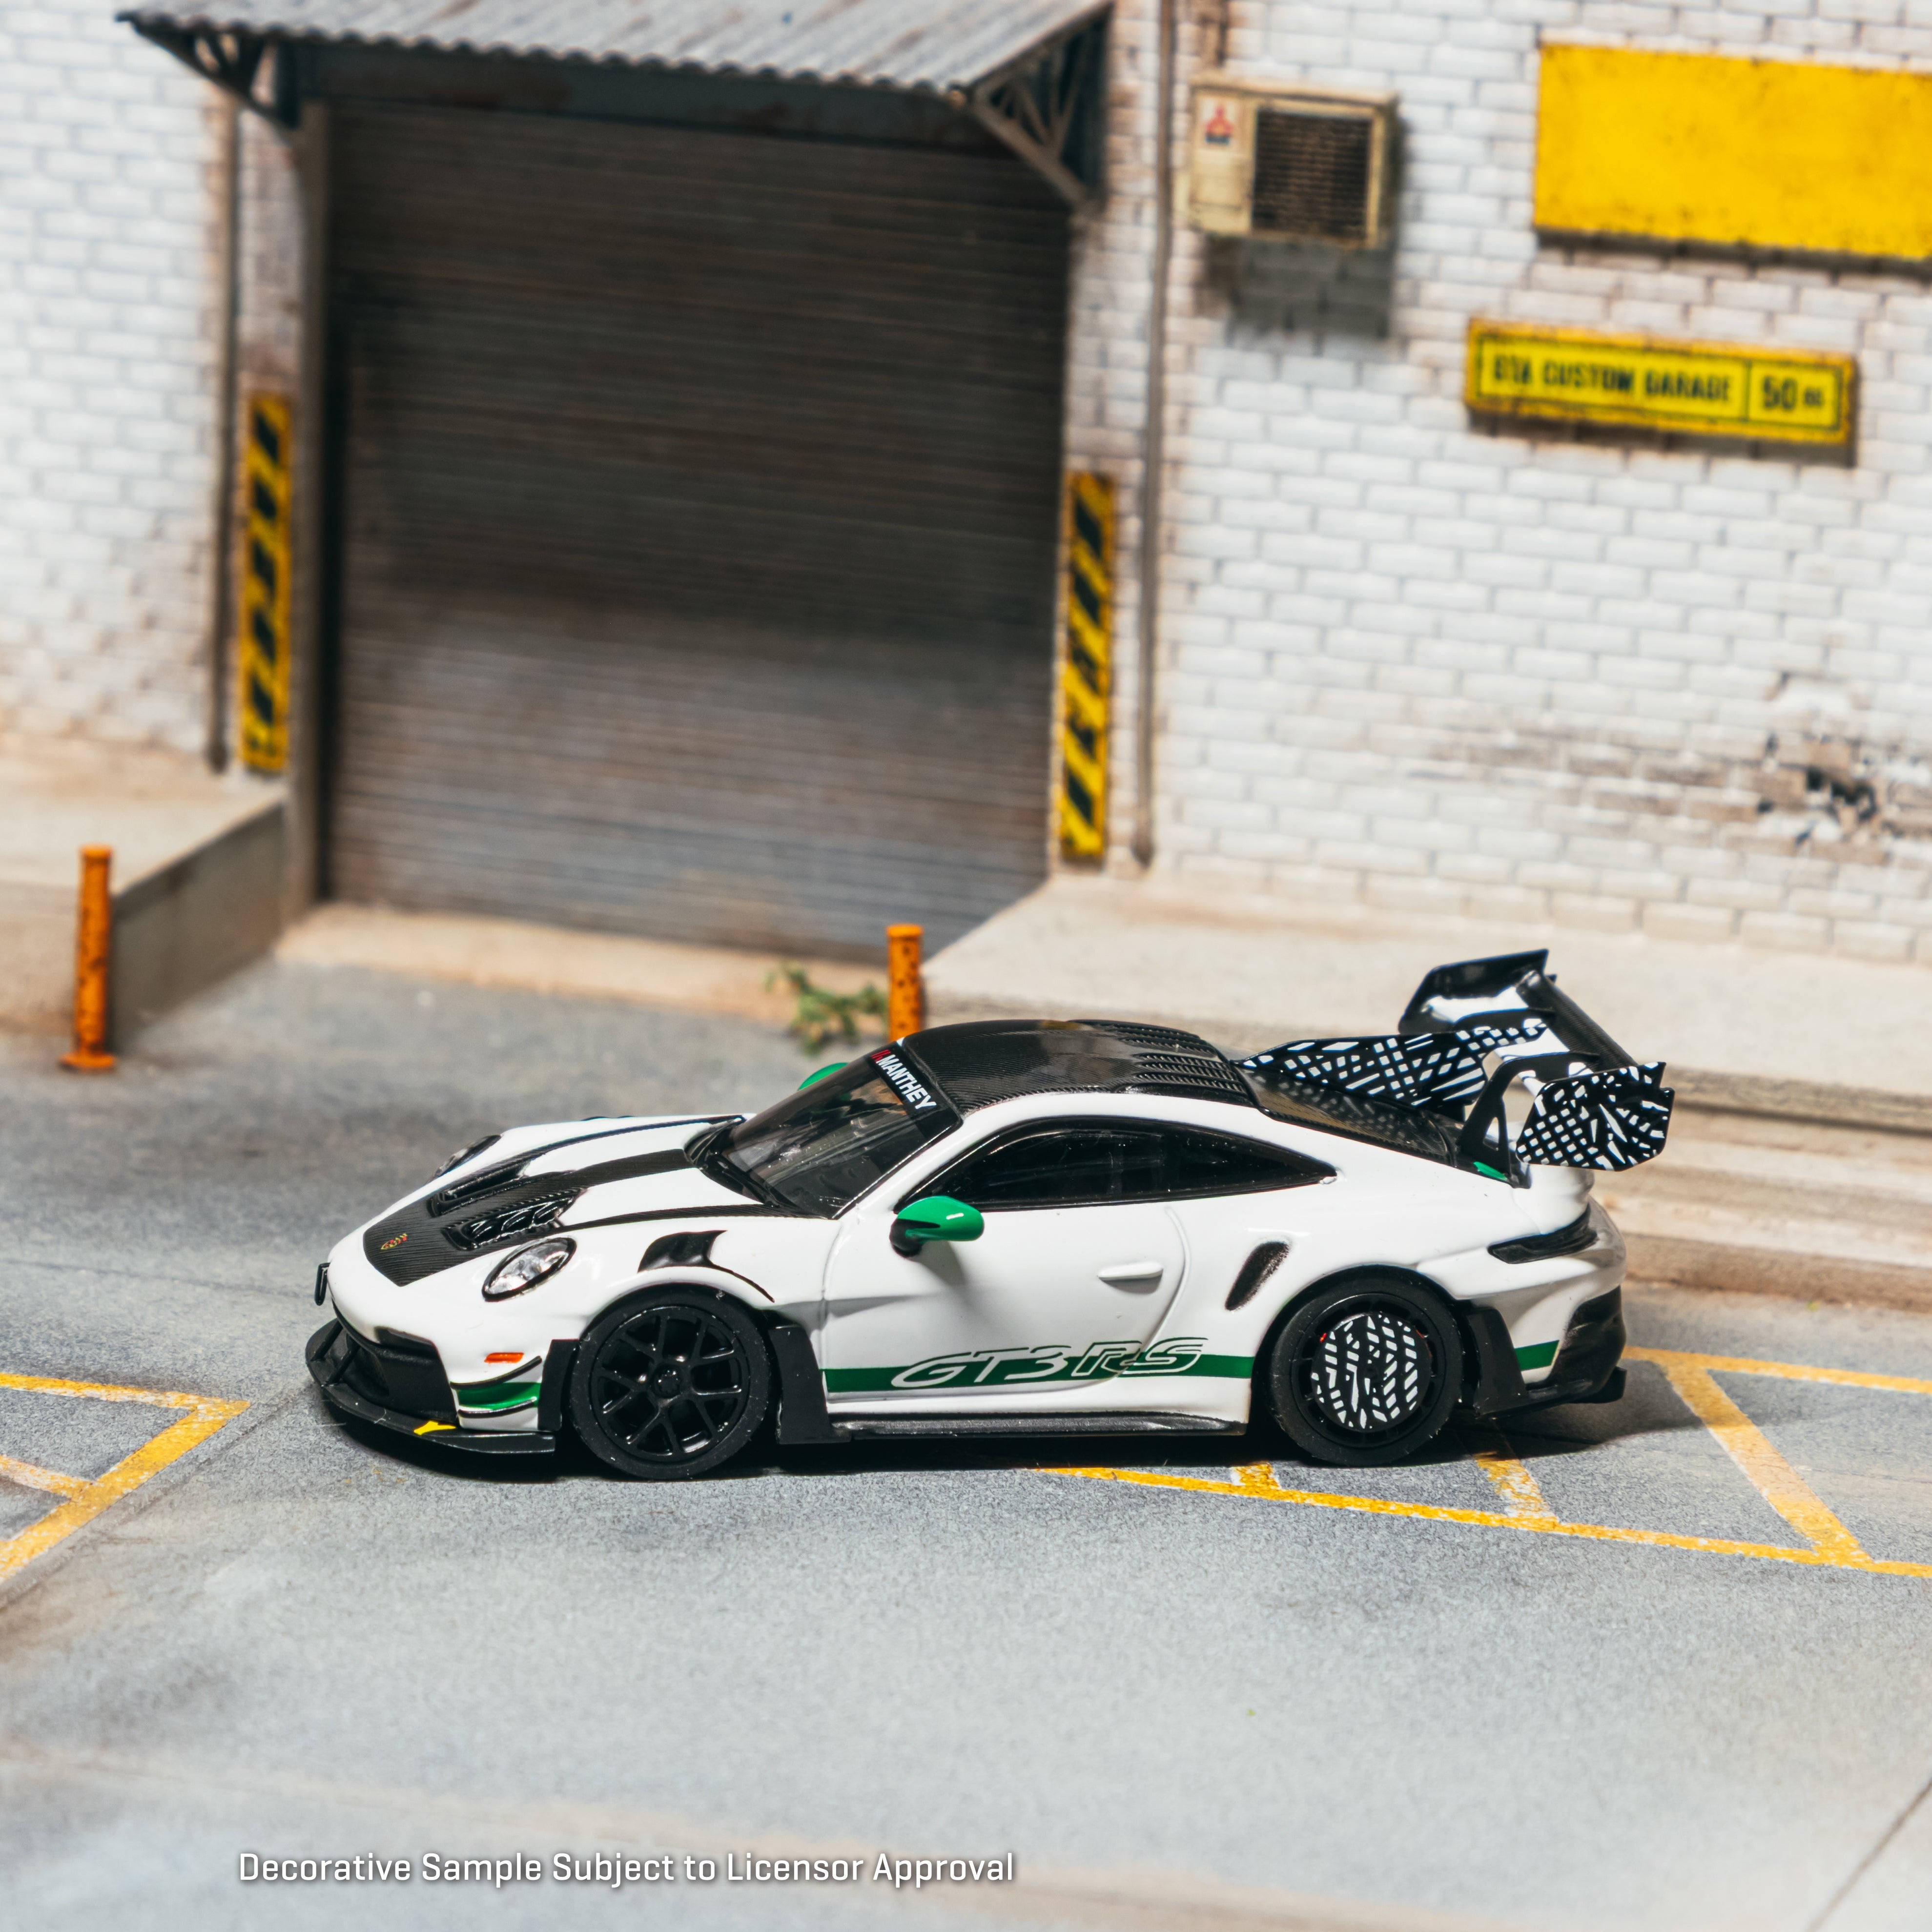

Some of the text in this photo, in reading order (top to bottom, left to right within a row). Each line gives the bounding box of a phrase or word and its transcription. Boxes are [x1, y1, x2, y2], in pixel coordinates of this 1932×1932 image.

[1543, 360, 1634, 392] CUSTOM
[1645, 370, 1730, 402] GARAGE
[875, 1054, 937, 1110] MANTHEY
